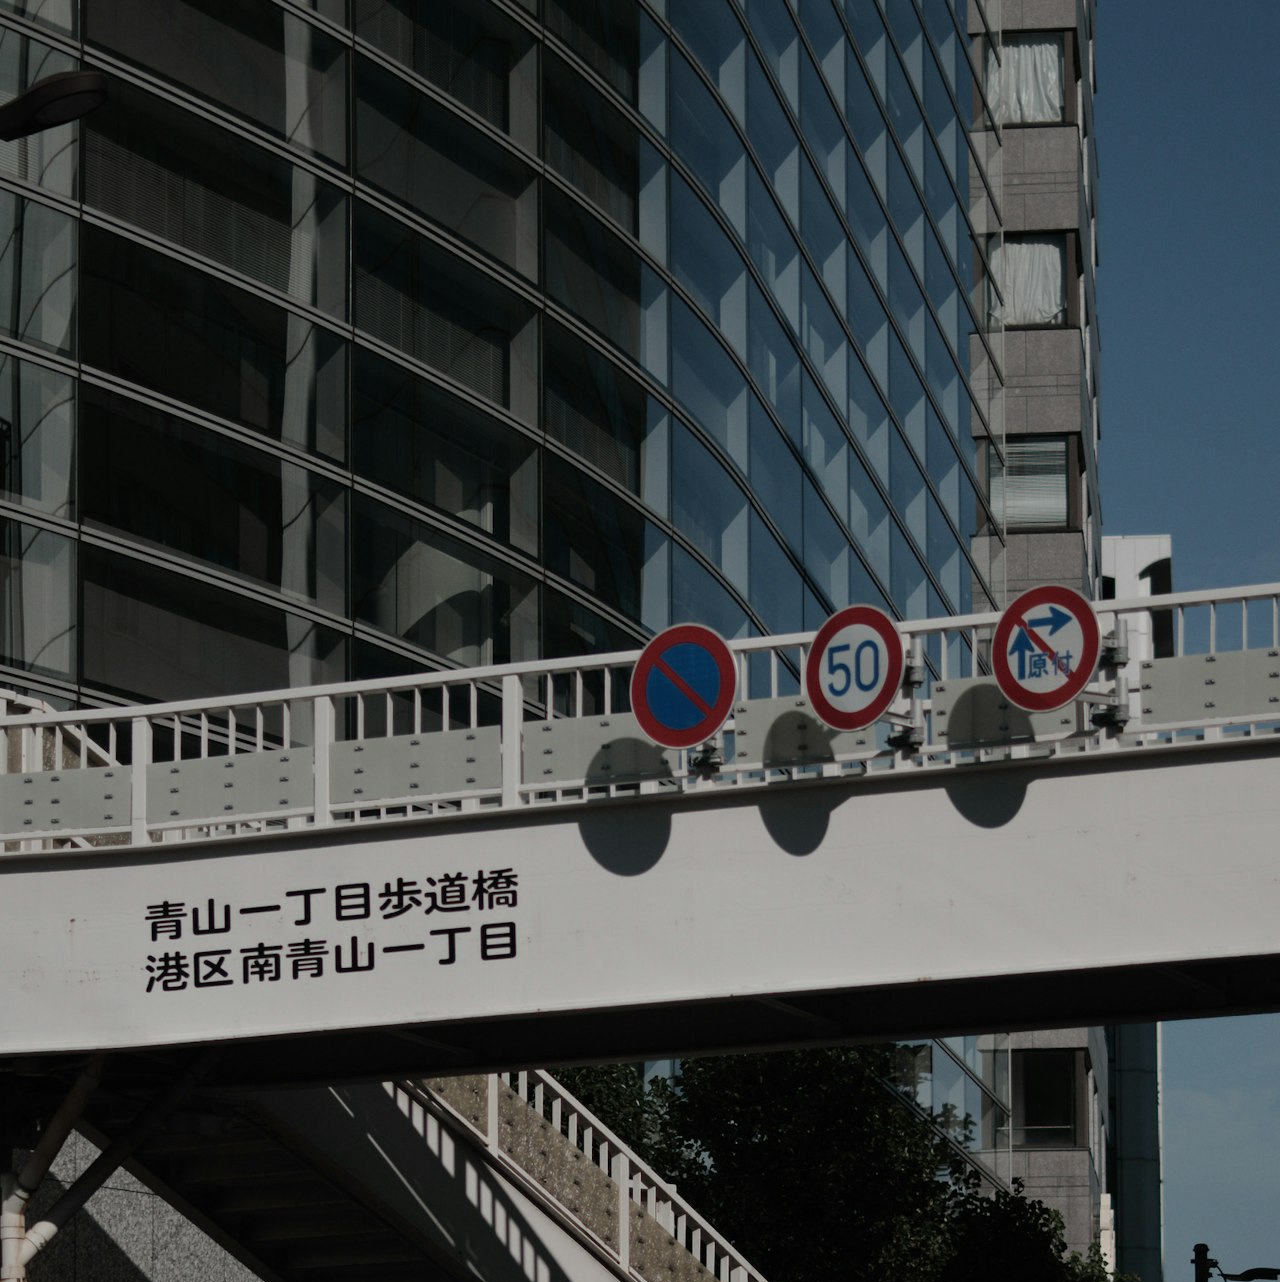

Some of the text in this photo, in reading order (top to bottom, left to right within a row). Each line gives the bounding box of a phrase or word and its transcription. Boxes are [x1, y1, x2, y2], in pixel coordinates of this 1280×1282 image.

[827, 639, 880, 698] 50
[1027, 651, 1072, 679] 原付
[145, 868, 518, 941] 青山一丁目歩道橋
[146, 922, 516, 993] 港区南青山一丁目
